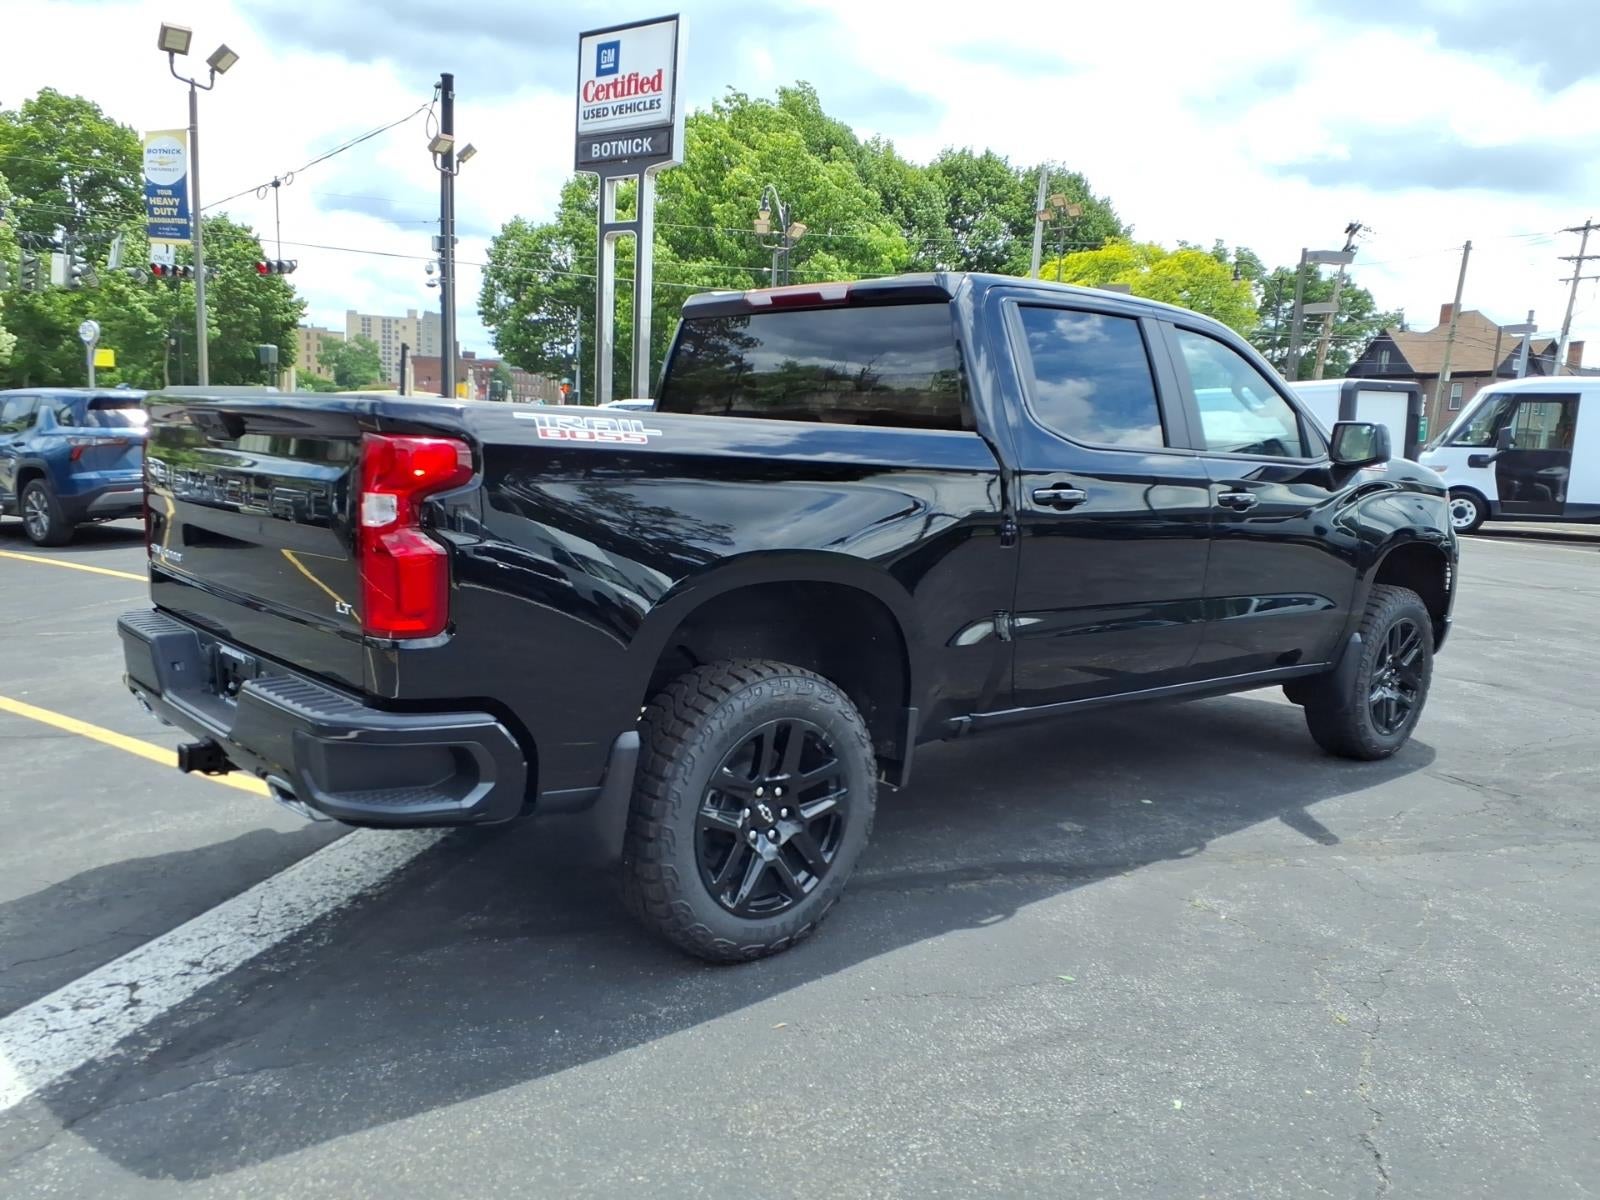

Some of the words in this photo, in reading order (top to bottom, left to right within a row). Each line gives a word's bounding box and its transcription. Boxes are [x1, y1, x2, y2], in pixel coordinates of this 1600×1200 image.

[601, 48, 615, 64] GM
[583, 69, 663, 103] Certified
[583, 107, 609, 120] USED
[611, 98, 662, 117] VEHICLES
[592, 137, 653, 158] BOTNICK
[149, 197, 180, 206] HEAVY
[153, 207, 178, 216] DUTY
[153, 254, 171, 262] ONLY
[513, 412, 662, 436] TRAIL
[538, 428, 648, 444] BOSS
[336, 601, 352, 615] LT
